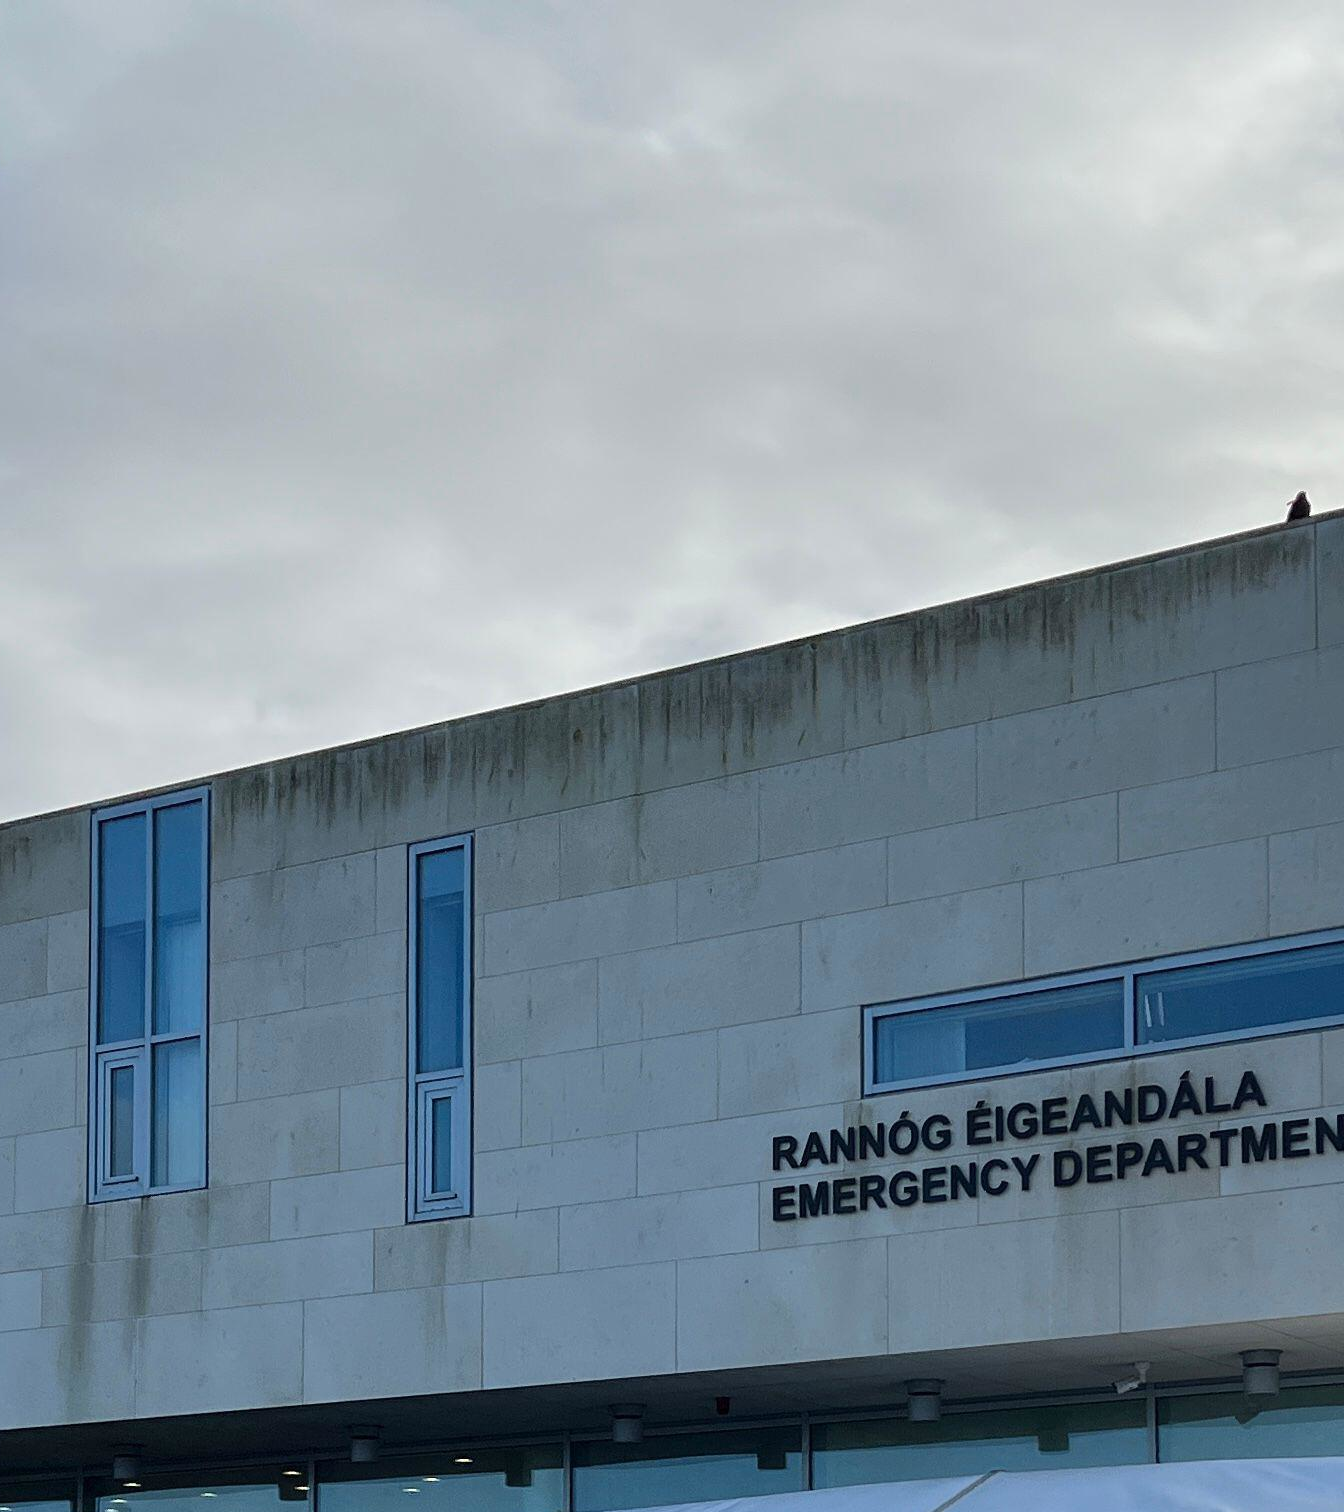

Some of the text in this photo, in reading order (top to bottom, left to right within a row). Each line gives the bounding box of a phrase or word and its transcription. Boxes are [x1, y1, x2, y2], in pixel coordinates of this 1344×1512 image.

[772, 1070, 1268, 1170] RANNÓG ÉIGEANDÁLA
[772, 1153, 1041, 1222] EMERGENCY
